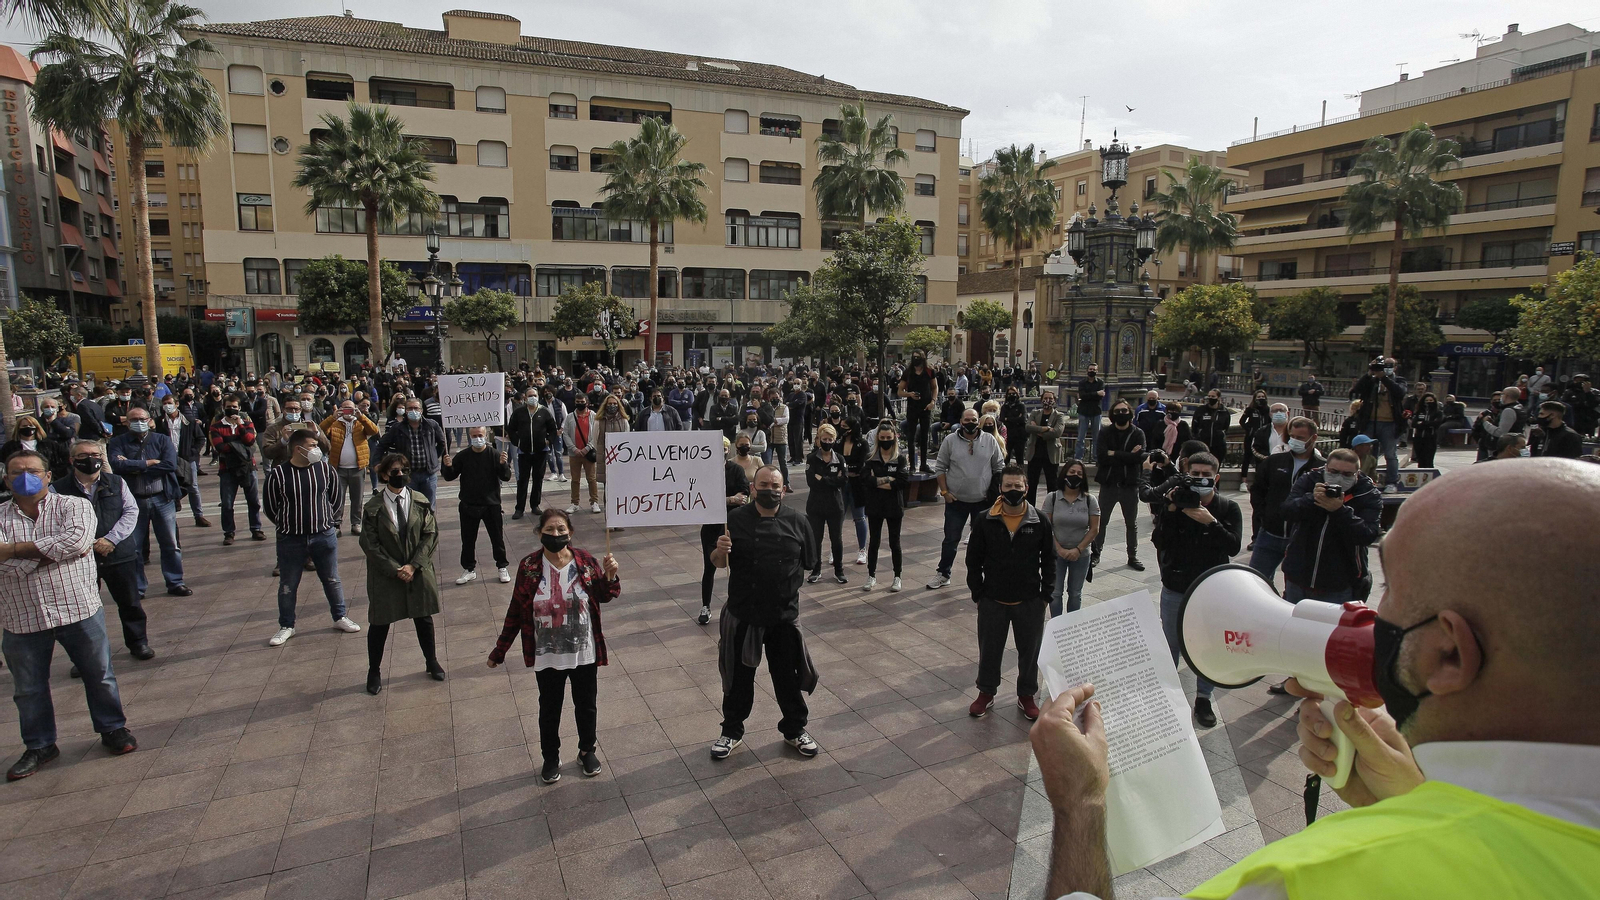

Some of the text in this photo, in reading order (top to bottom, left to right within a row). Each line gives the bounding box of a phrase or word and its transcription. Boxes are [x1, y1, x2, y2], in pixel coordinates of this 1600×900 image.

[3, 90, 36, 265] EDIFICIO CENTRO
[457, 376, 486, 388] SOLO
[444, 391, 500, 407] QUEREMOS
[445, 411, 500, 424] TRABAJAR
[606, 442, 712, 465] #SALVEMOS
[652, 466, 676, 482] LA
